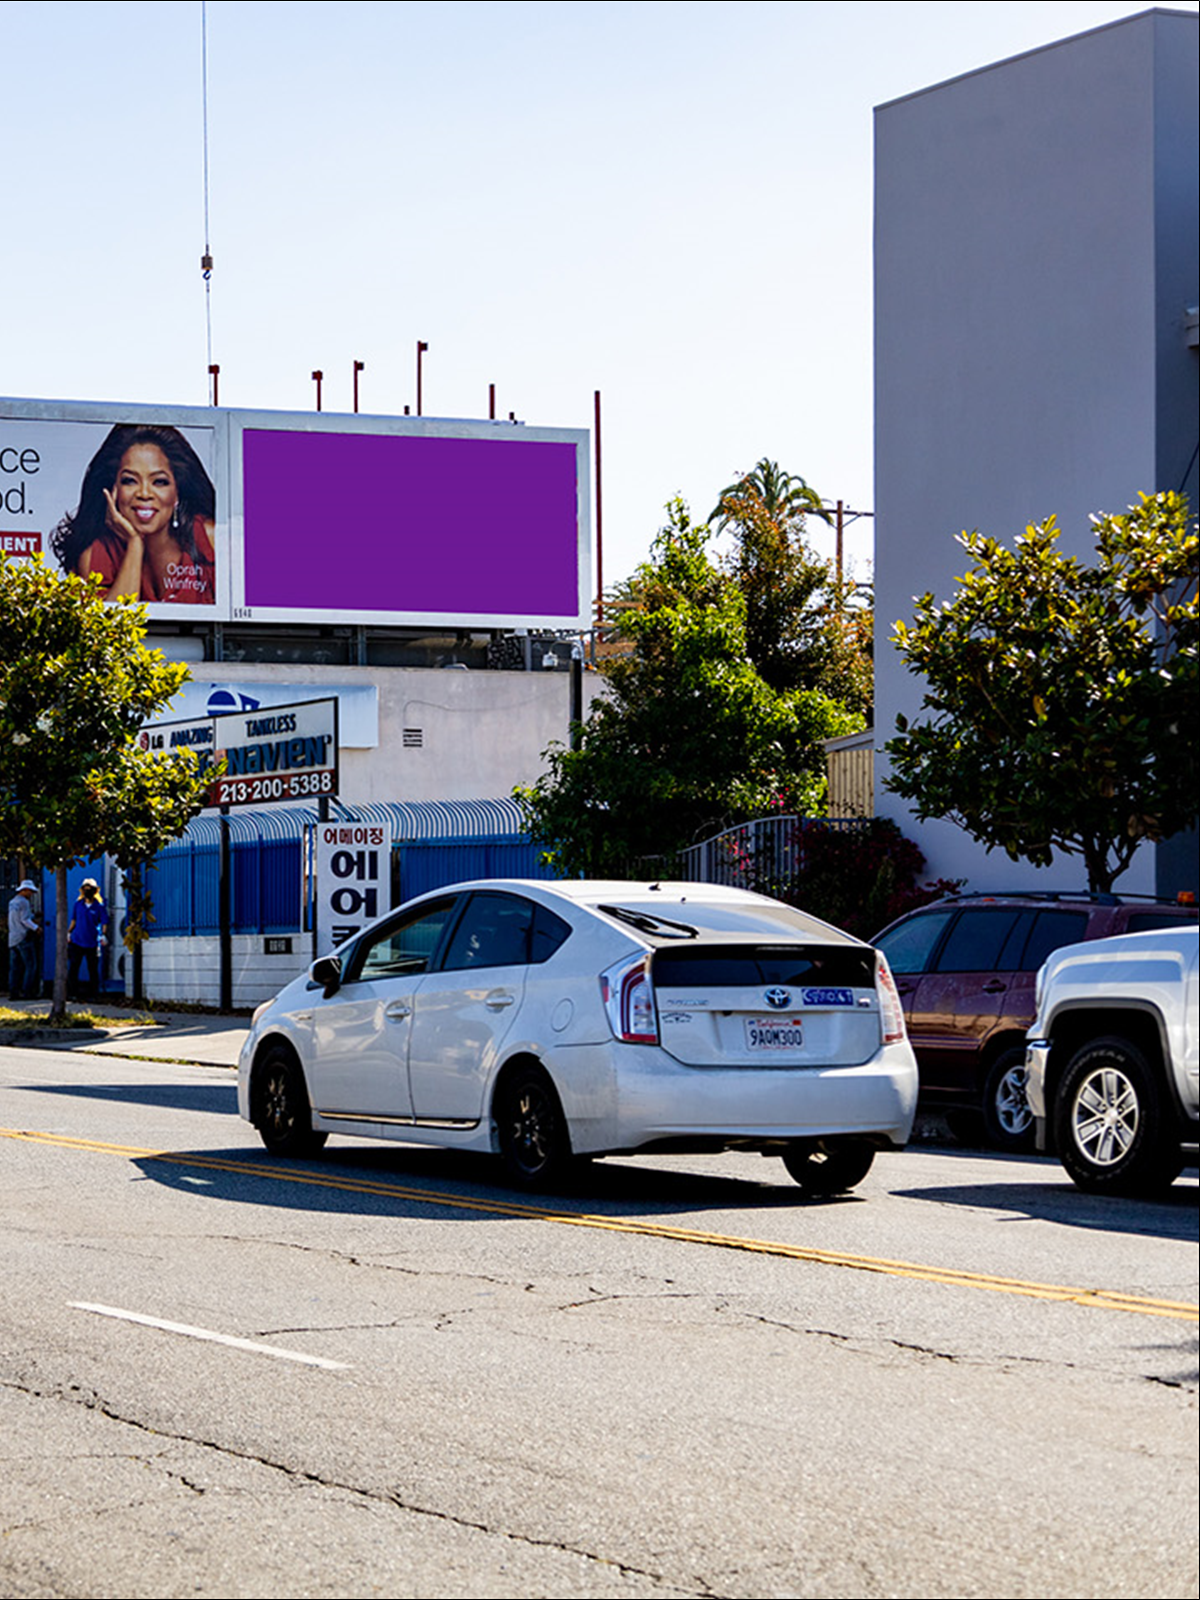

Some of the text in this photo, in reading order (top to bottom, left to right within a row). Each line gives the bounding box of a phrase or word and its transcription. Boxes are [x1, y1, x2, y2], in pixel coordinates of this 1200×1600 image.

[166, 562, 203, 577] Oprah
[163, 577, 207, 593] Winfrey
[245, 713, 297, 737] TANKLESS
[151, 726, 213, 750] LG AMAZING
[323, 827, 384, 846] 어메이징
